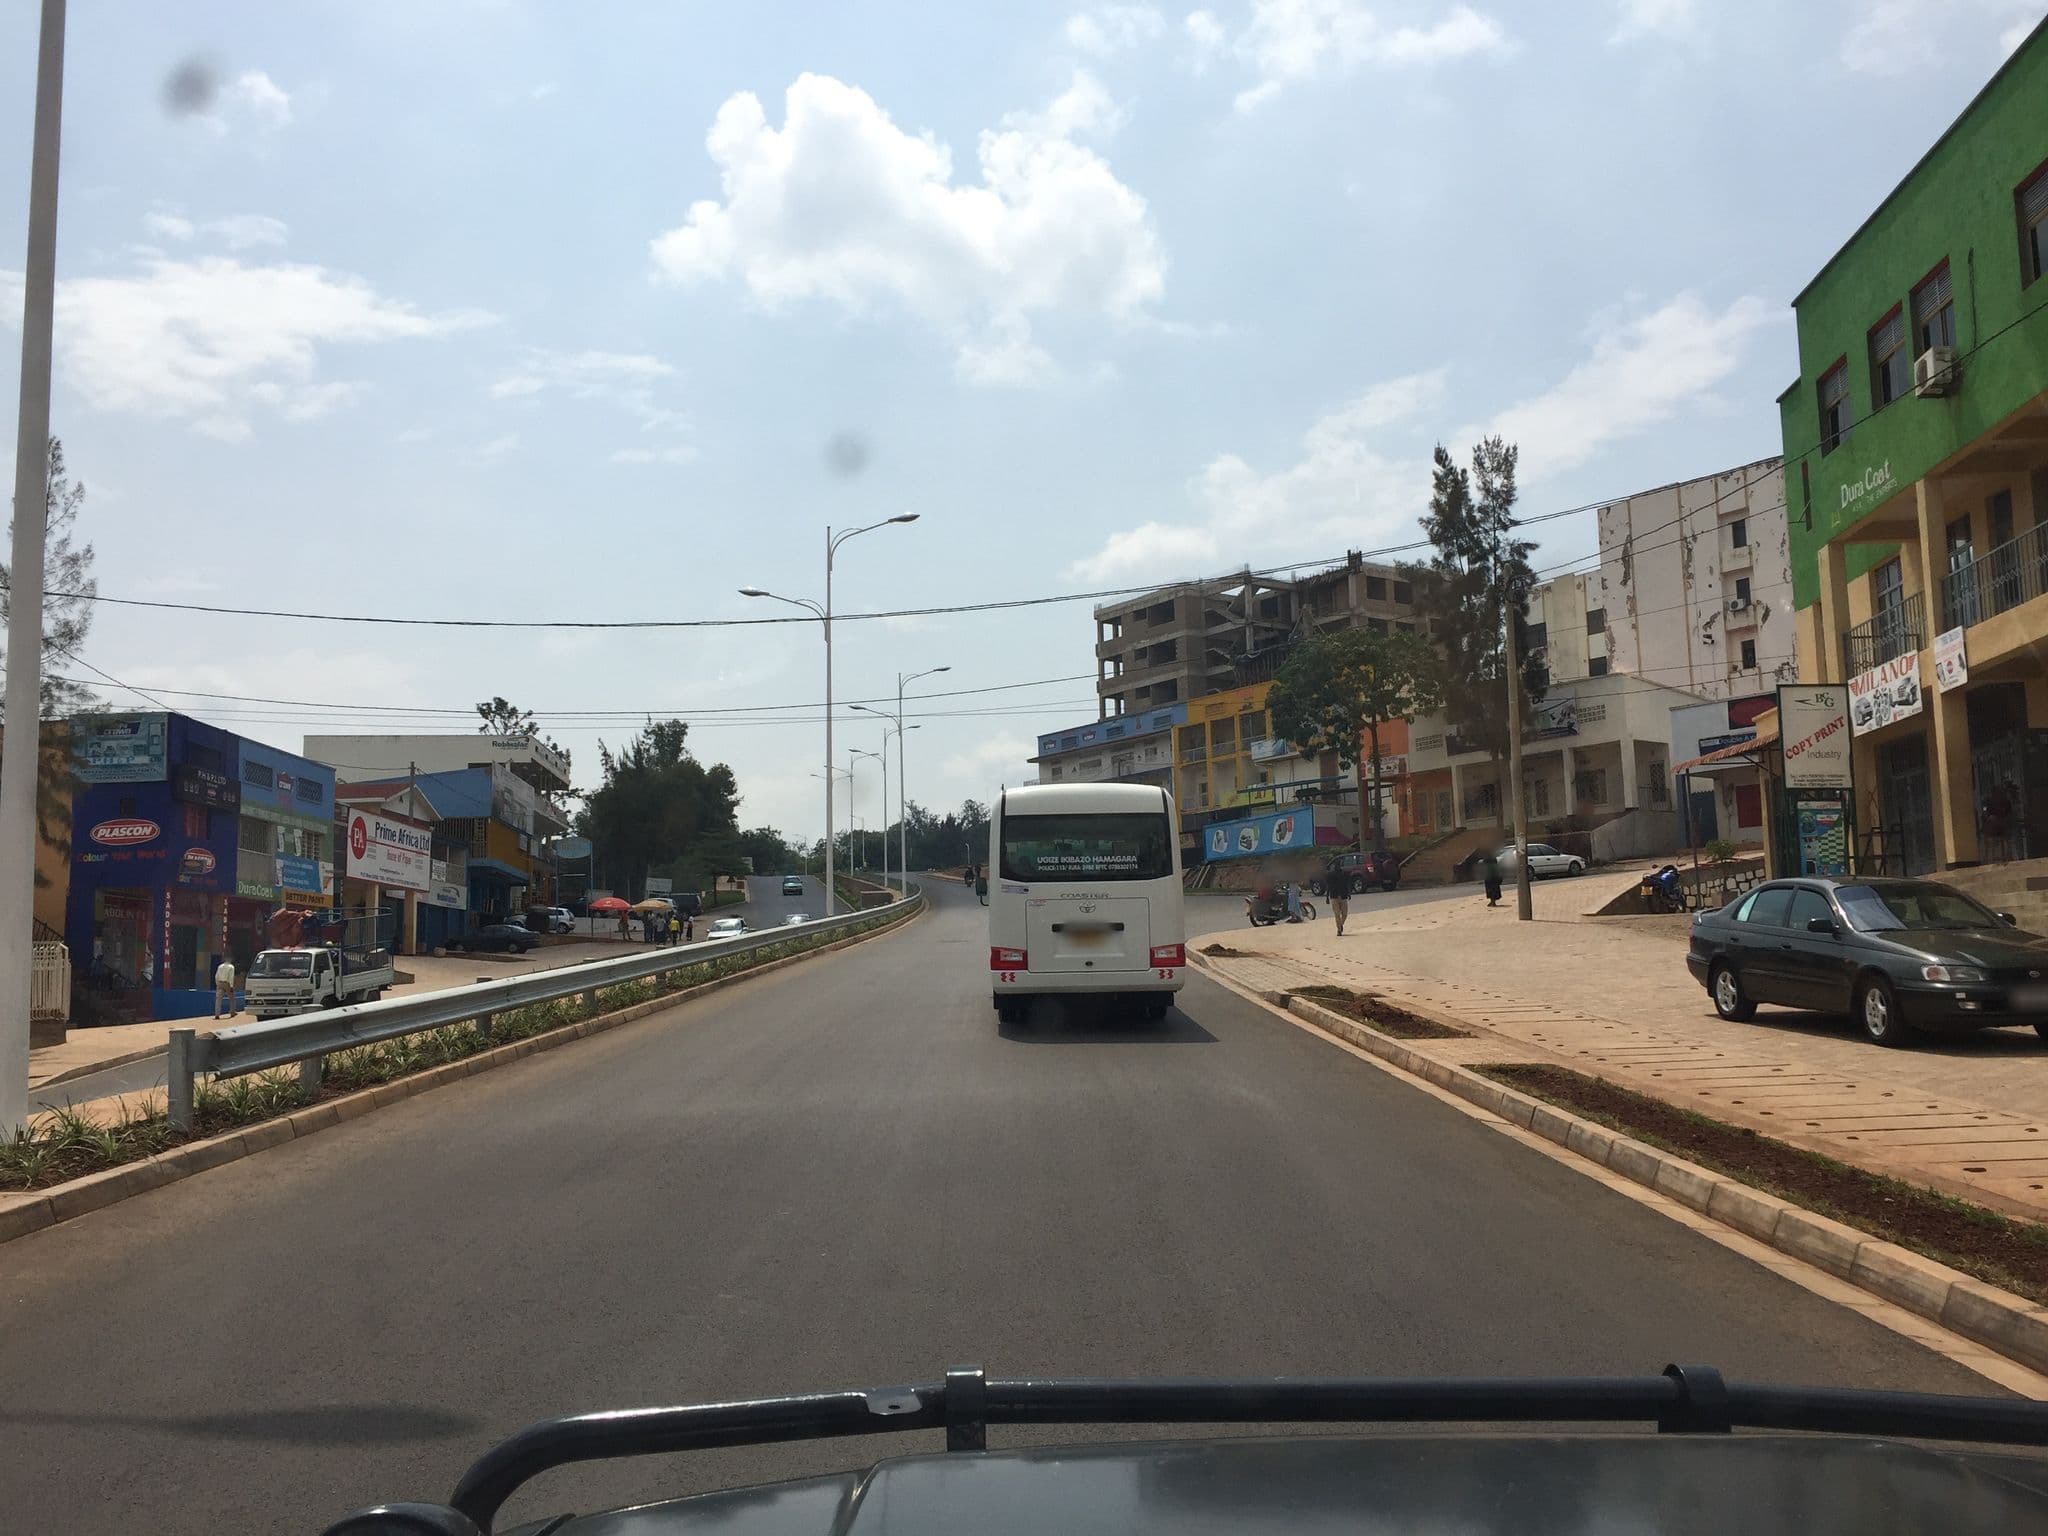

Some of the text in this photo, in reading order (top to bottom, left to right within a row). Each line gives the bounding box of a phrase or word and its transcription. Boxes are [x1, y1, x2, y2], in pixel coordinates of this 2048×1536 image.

[1840, 458, 1890, 509] Dura Coat
[1854, 656, 1909, 696] MILANO
[1785, 735, 1813, 760] COPY
[1813, 715, 1845, 743] PRINT
[1807, 750, 1842, 761] Industry
[97, 826, 153, 838] PLASCON
[375, 821, 431, 851] Prime Africa Ltd
[1037, 856, 1059, 864] UGIZE
[1092, 855, 1137, 863] HAMAGARA
